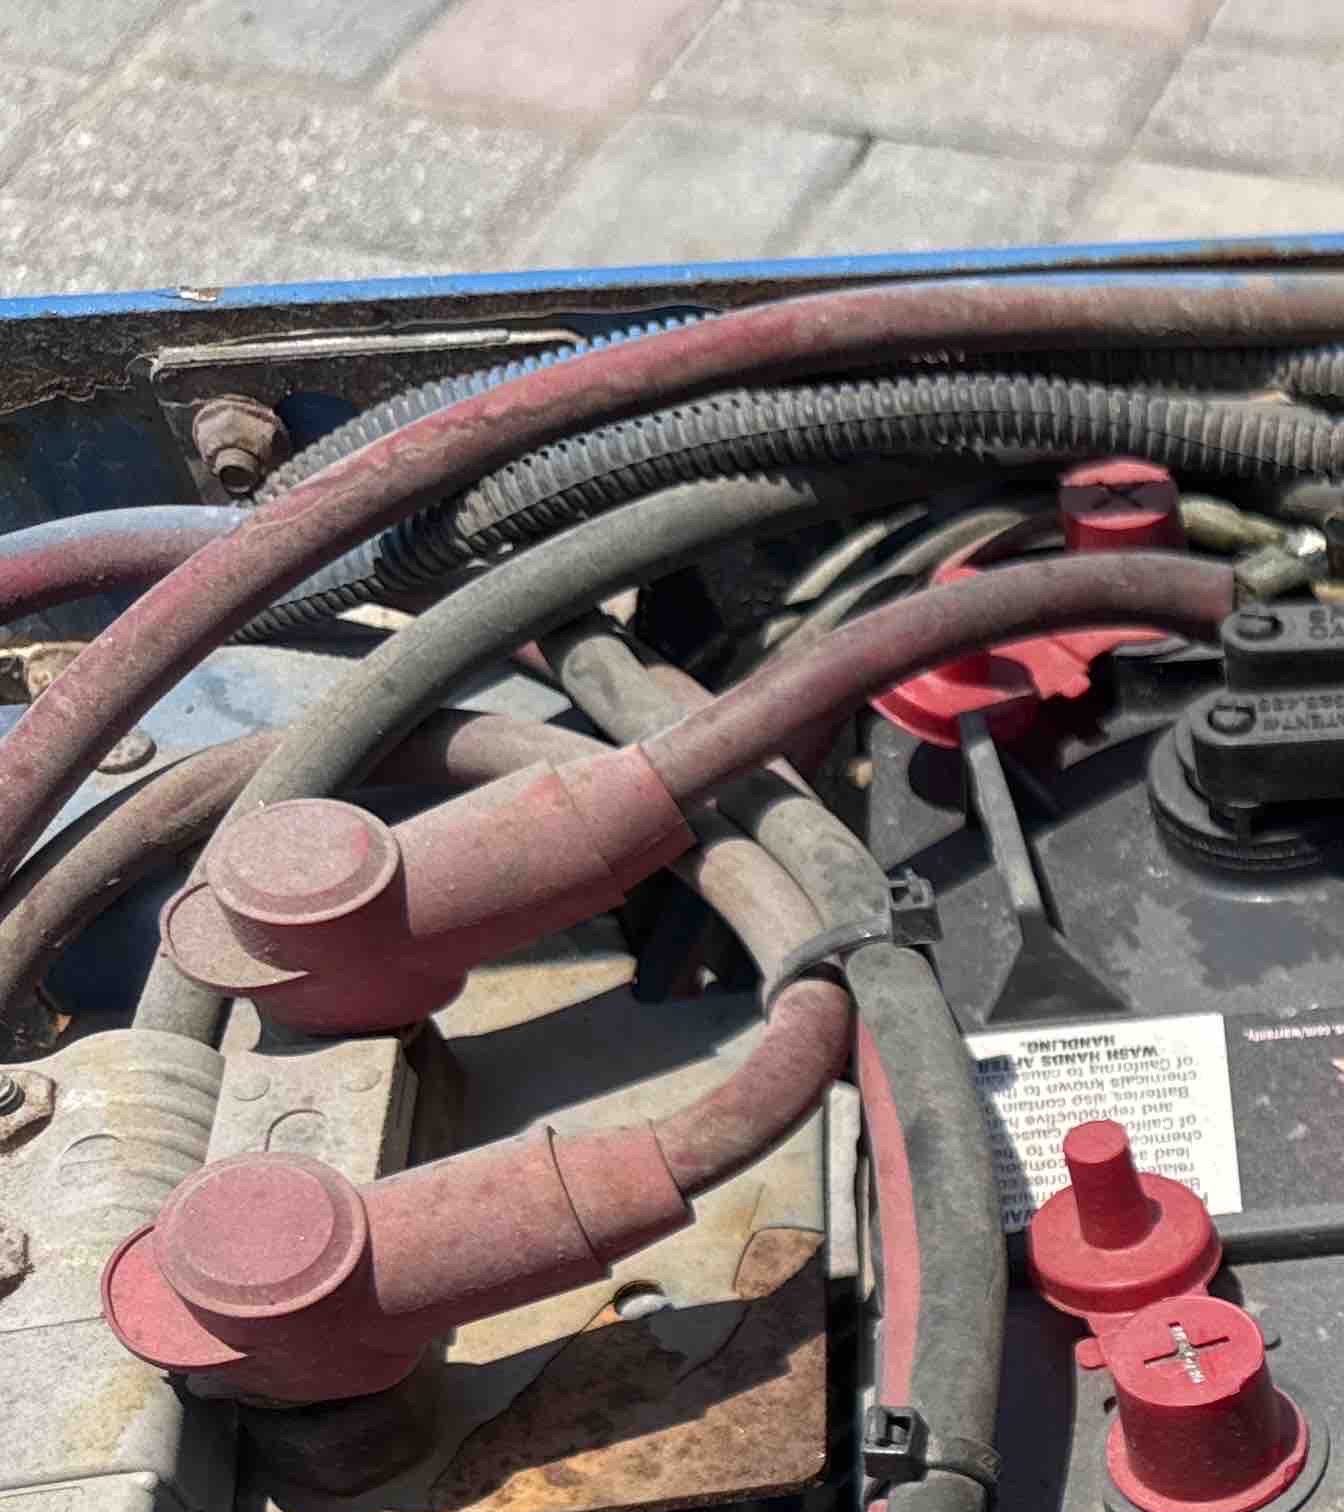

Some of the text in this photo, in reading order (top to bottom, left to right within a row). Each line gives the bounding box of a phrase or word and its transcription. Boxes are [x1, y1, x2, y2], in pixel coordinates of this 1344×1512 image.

[1018, 1031, 1115, 1057] HANDLING.
[1105, 1043, 1157, 1062] WASH
[1039, 1048, 1101, 1069] HANDS
[1175, 1054, 1192, 1068] of
[1023, 1067, 1196, 1098] chemicals known to
[1065, 1066, 1084, 1080] to
[1001, 1096, 1066, 1115] contain
[1070, 1091, 1107, 1107] also
[1022, 1100, 1173, 1129] and reproductive
[1154, 1145, 1189, 1159] lead
